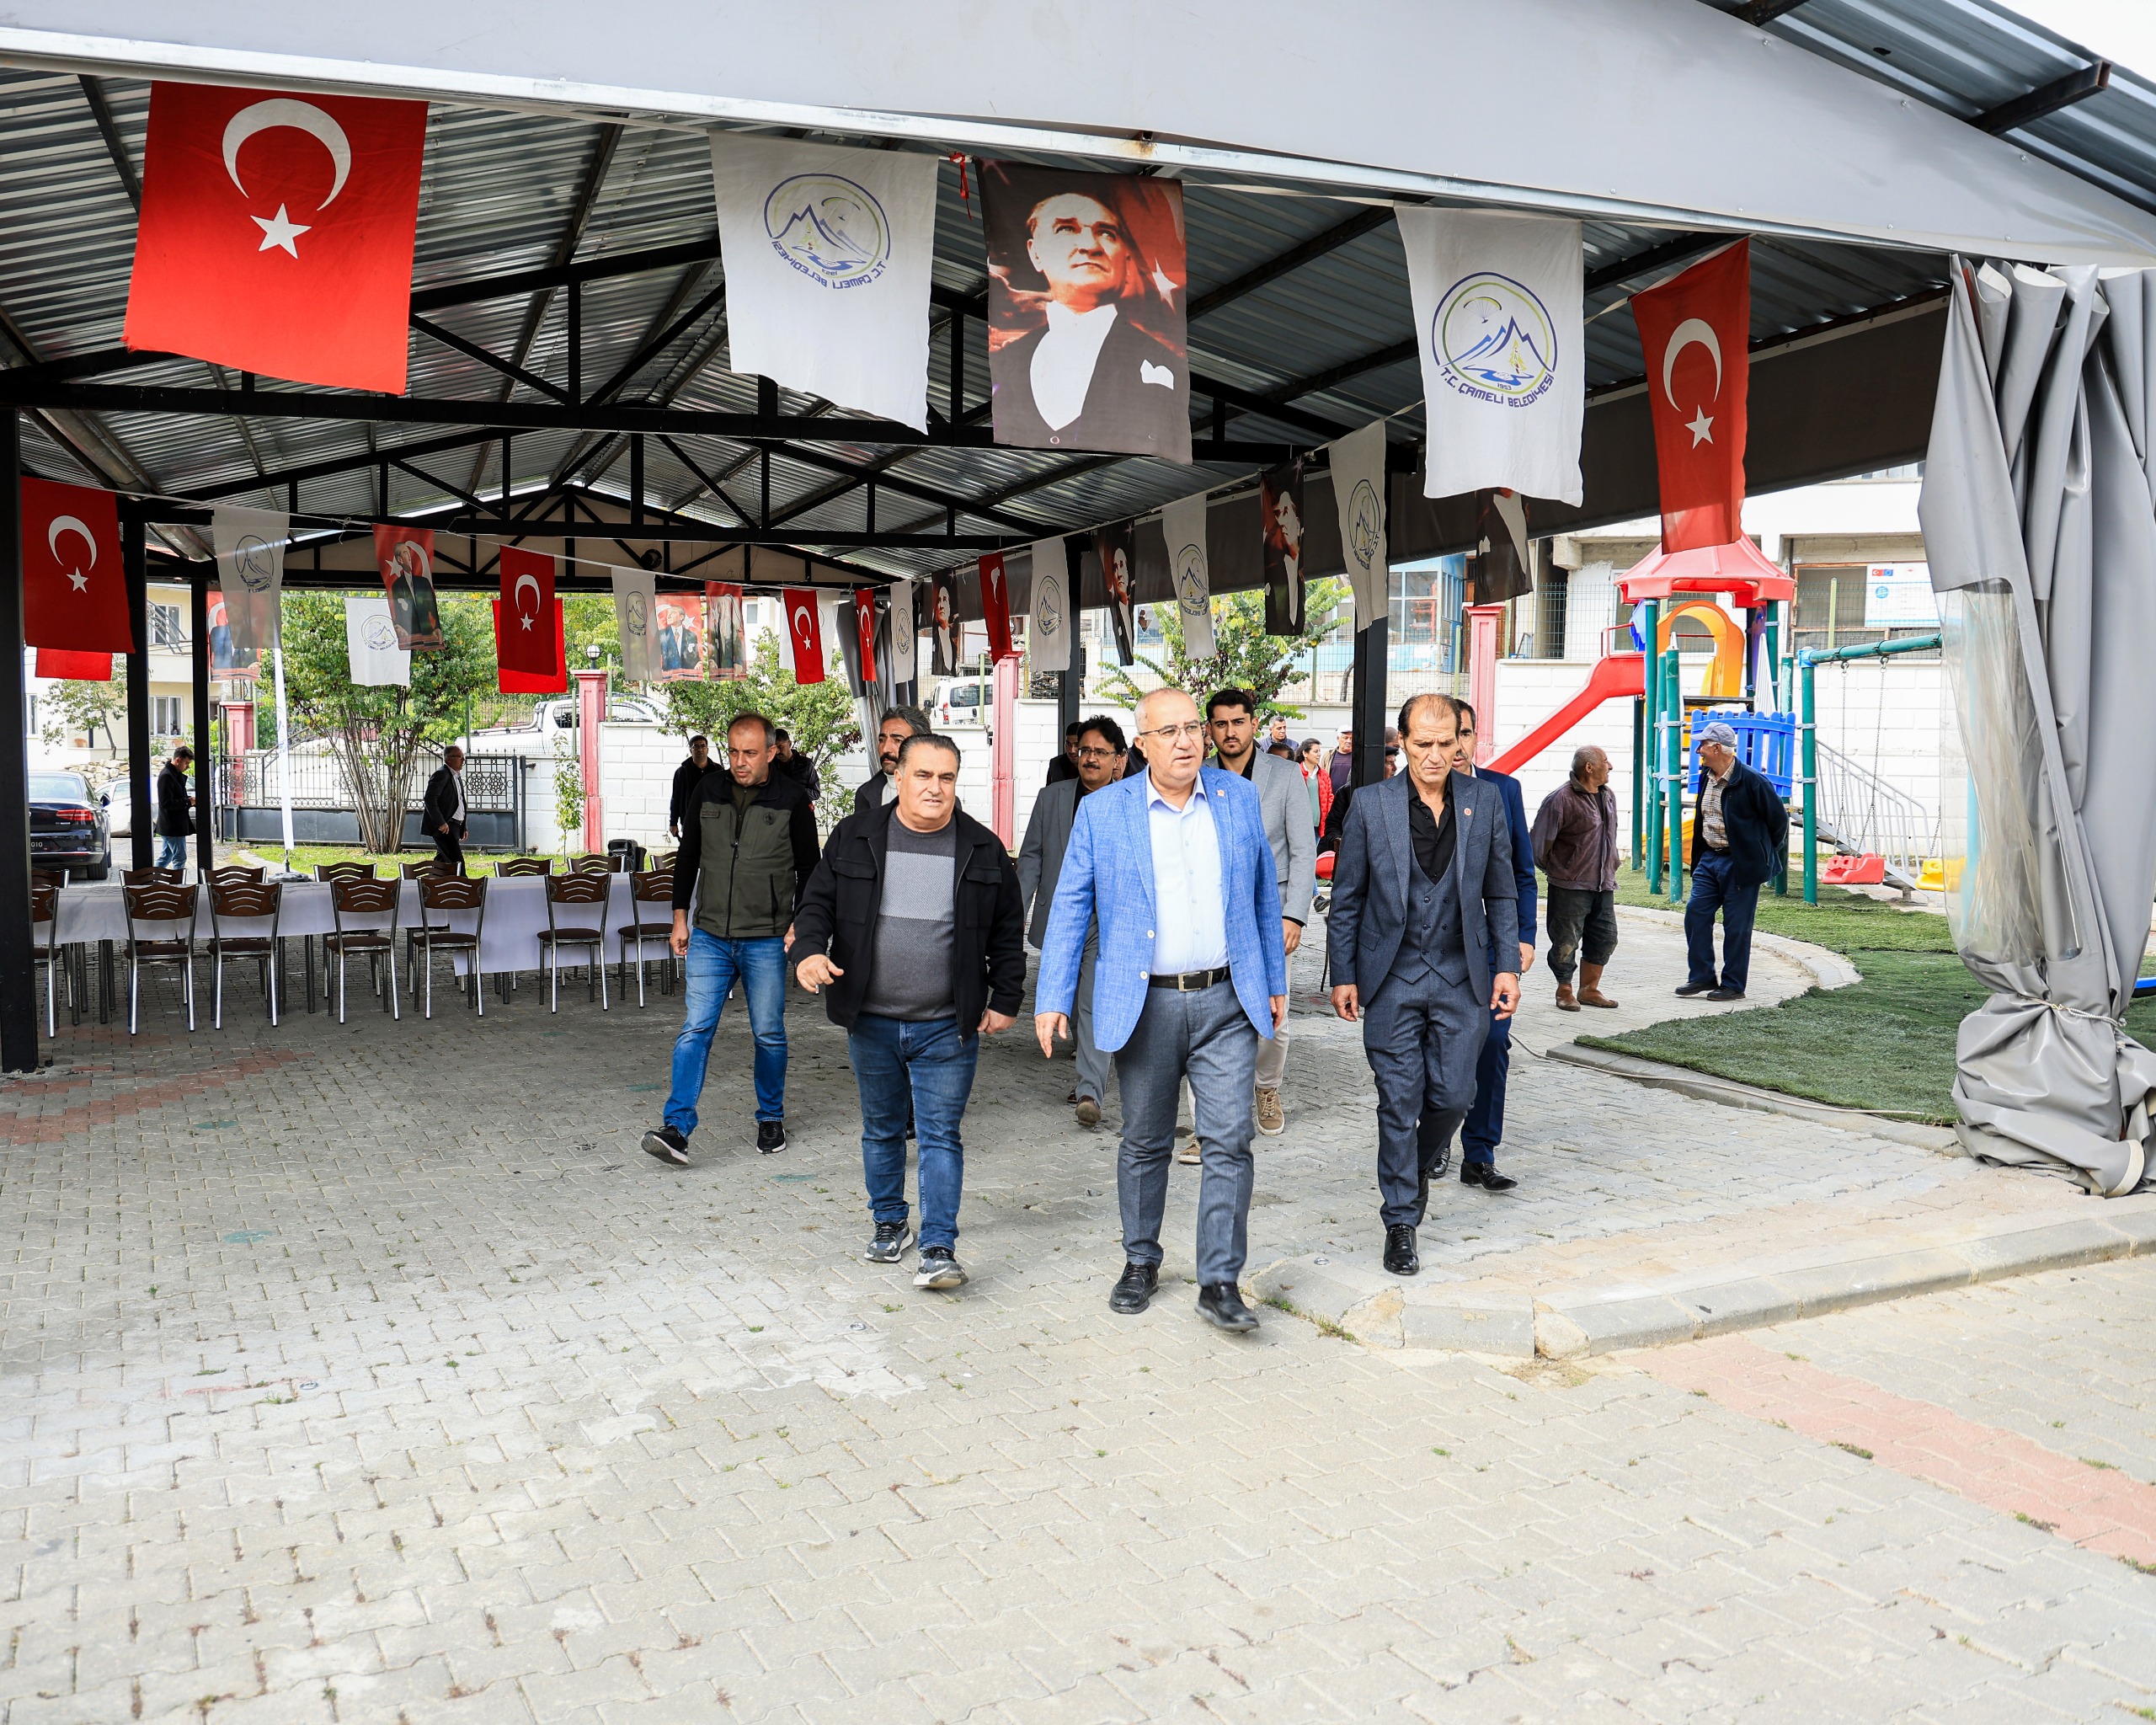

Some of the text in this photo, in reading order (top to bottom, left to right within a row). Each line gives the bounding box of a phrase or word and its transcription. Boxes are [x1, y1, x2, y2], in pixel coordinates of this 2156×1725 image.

[1440, 366, 1555, 408] T.C. ÇAMELİ BELEDİYESİ
[1497, 382, 1513, 391] 1953
